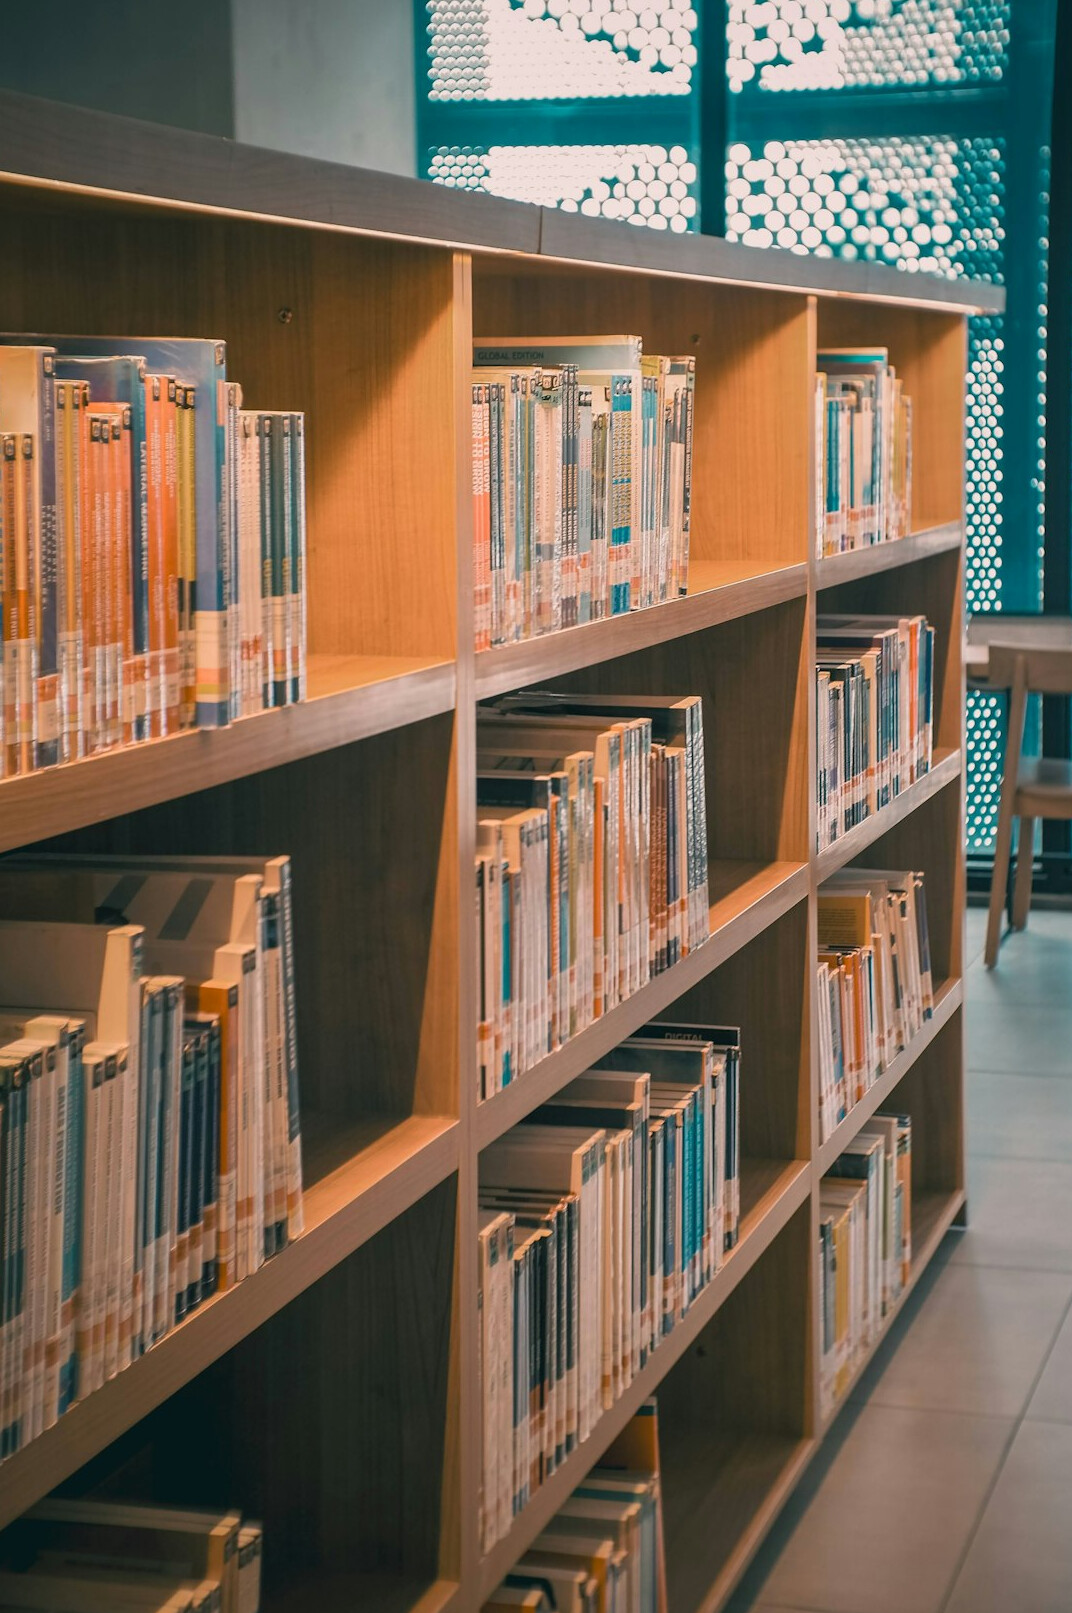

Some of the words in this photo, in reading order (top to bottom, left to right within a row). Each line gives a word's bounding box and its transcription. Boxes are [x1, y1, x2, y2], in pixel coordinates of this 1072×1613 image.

[478, 351, 508, 360] GLOBAL
[512, 351, 544, 360] EDITION
[472, 442, 478, 457] TO
[477, 443, 484, 457] TO
[483, 440, 490, 456] TO
[284, 894, 295, 977] CONSUMER
[286, 983, 297, 1070] BEHAVIOR
[664, 1032, 703, 1040] DIGITAL
[57, 1086, 66, 1128] SALES
[55, 1131, 65, 1216] PROMOTION
